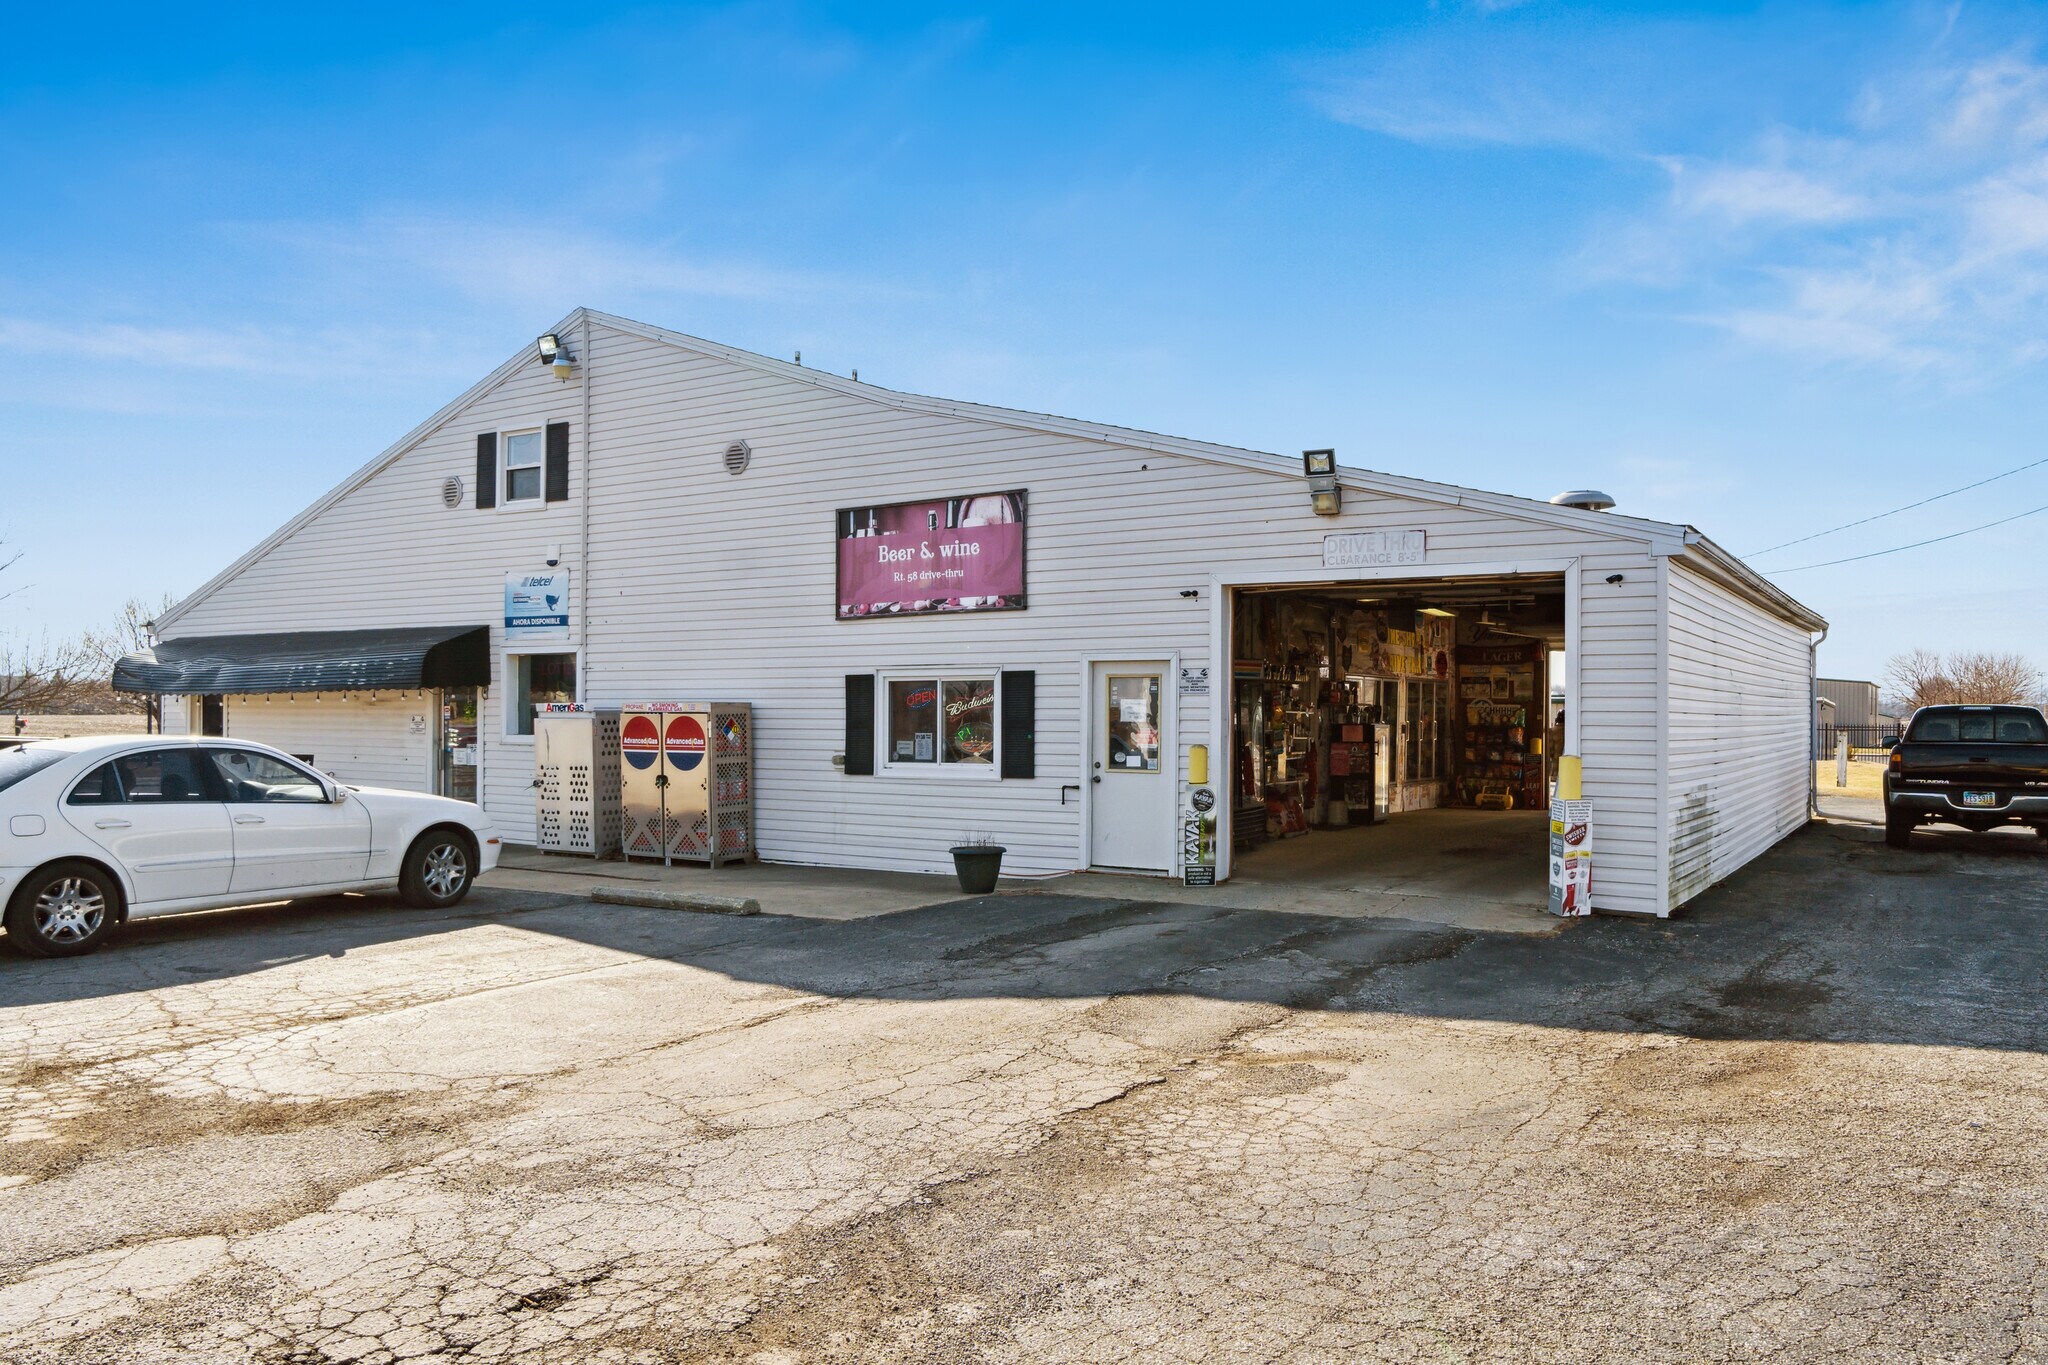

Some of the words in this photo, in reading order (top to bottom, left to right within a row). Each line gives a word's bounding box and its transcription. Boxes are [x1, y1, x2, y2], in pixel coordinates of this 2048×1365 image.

[1327, 536, 1375, 554] DRIVE
[1380, 533, 1421, 552] THRU
[878, 545, 915, 563] Beer
[920, 541, 934, 559] &
[939, 540, 980, 557] wine
[529, 575, 554, 587] telcel
[894, 572, 906, 582] Rt.
[907, 572, 918, 582] 58
[919, 568, 964, 580] drive-thru
[512, 618, 530, 626] AHORA
[531, 617, 561, 625] DISPONIBLE
[1482, 651, 1522, 662] LAGER
[906, 689, 936, 707] OPEN
[546, 703, 585, 712] AmeriGas
[648, 737, 658, 745] Gas
[666, 737, 691, 745] Advanced
[1193, 793, 1214, 804] KAYAK
[1185, 809, 1200, 864] KAYAK
[1565, 826, 1586, 841] SWISHER
